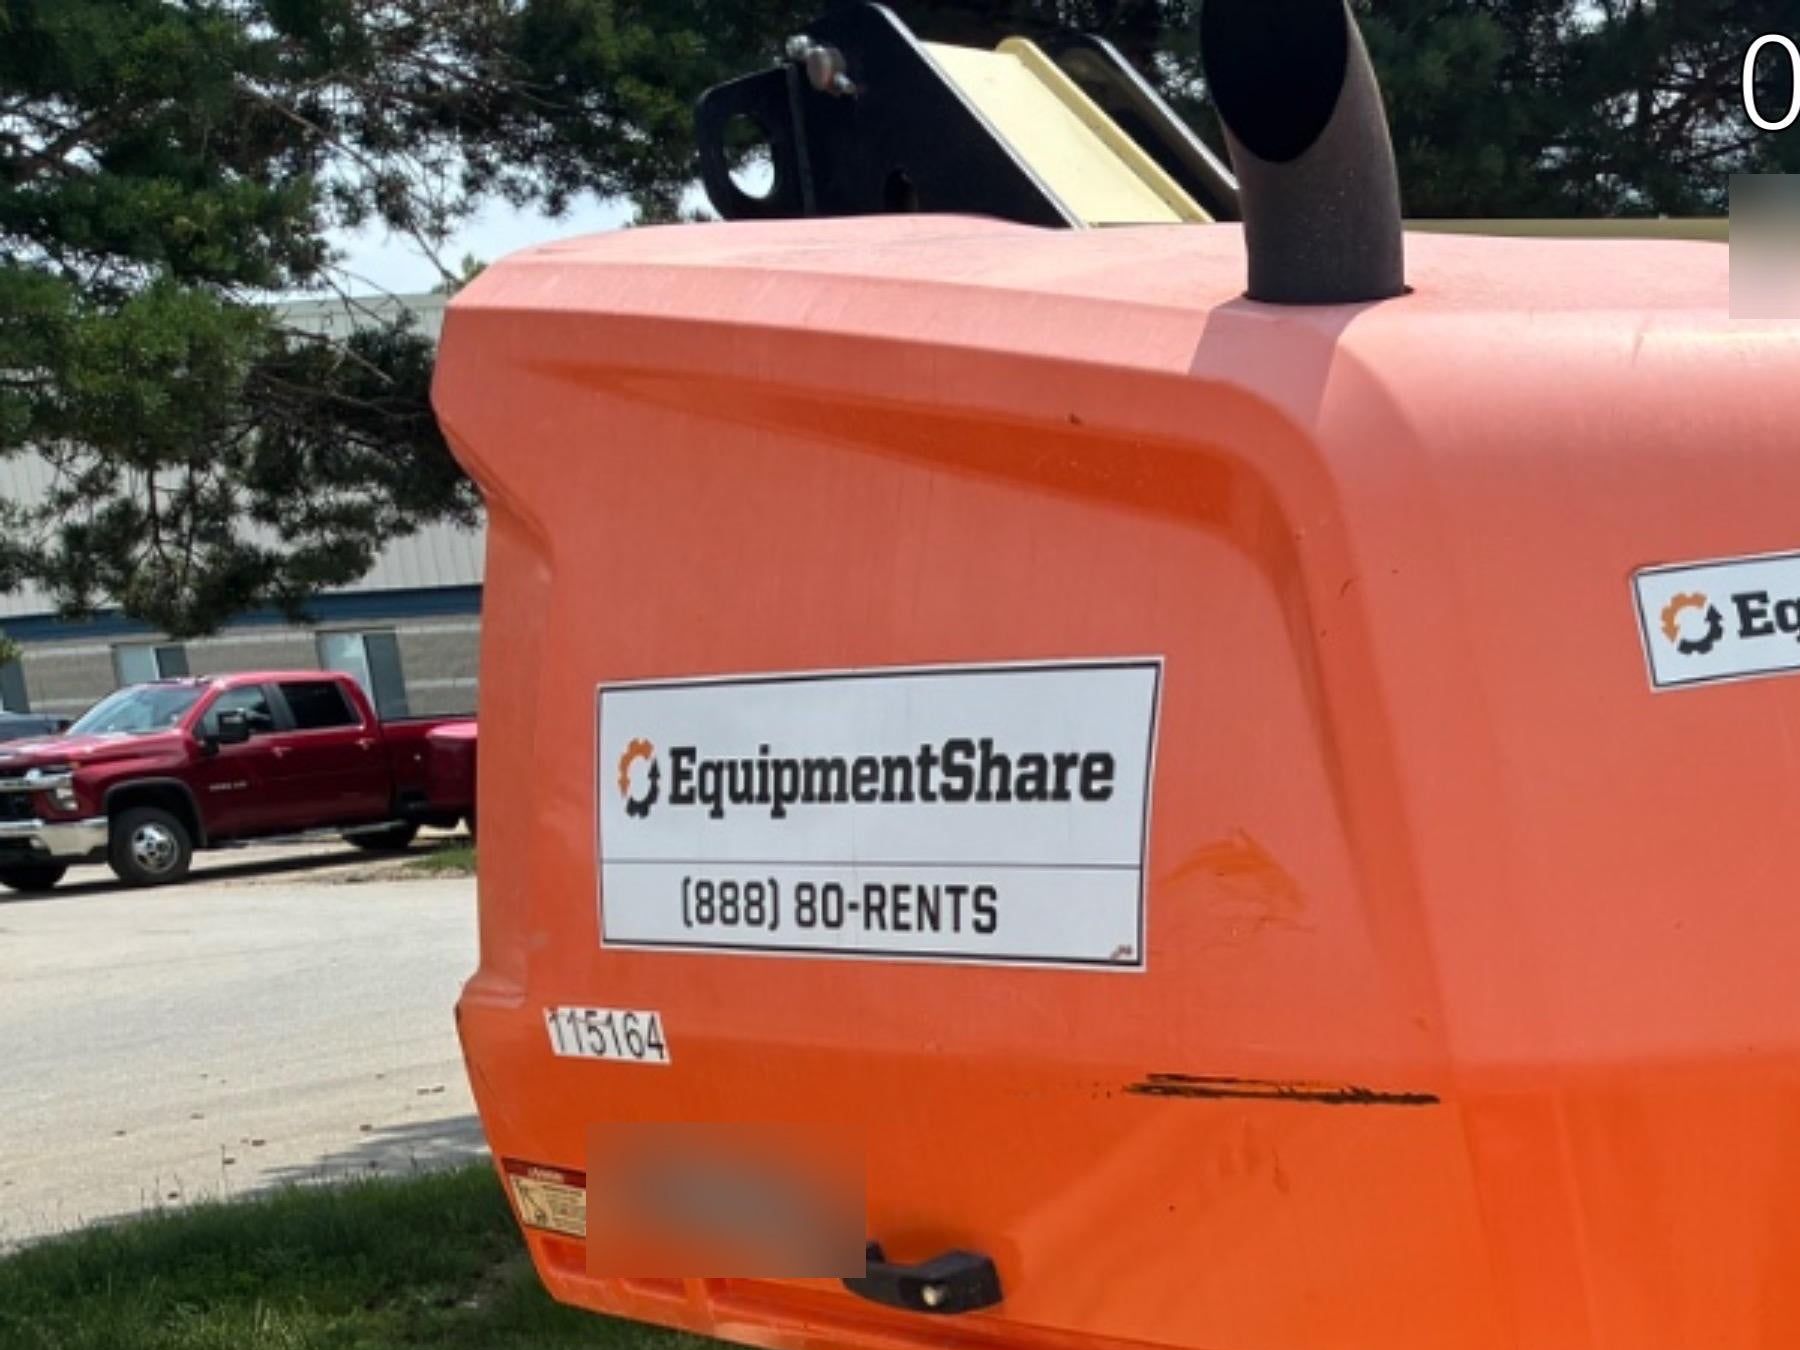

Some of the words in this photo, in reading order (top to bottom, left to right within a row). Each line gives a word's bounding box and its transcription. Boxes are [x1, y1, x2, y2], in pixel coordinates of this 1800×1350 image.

[669, 739, 1116, 819] EquipmentShare
[682, 877, 780, 931] (888)
[794, 882, 998, 934] 80-RENTS
[549, 1008, 664, 1060] 115164
